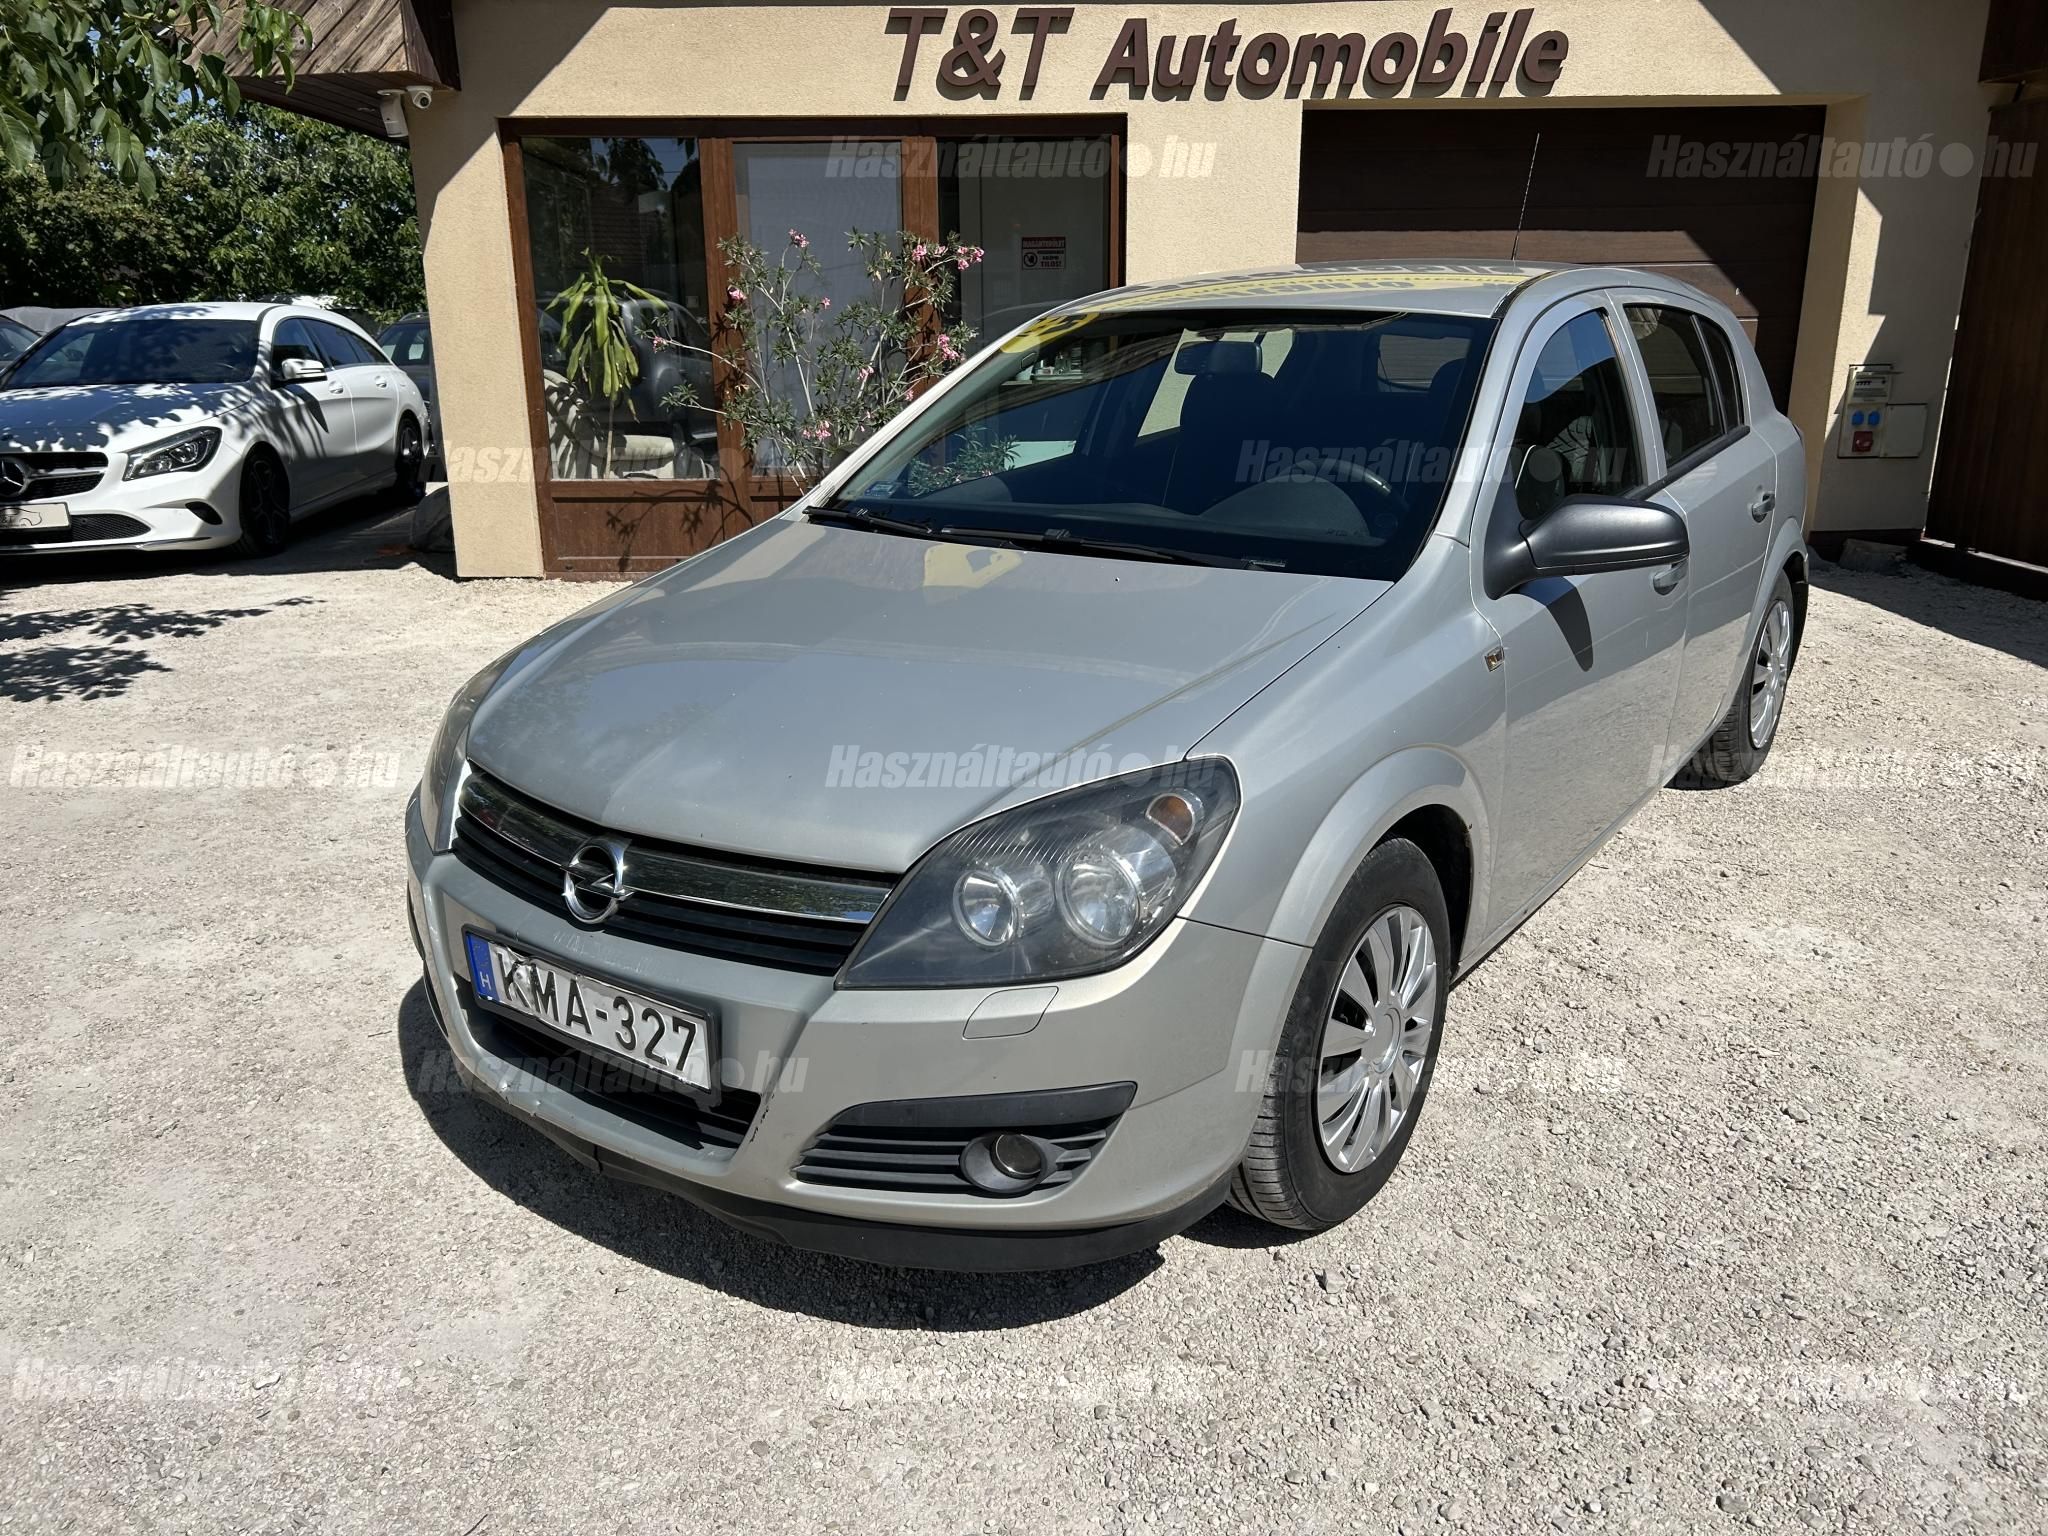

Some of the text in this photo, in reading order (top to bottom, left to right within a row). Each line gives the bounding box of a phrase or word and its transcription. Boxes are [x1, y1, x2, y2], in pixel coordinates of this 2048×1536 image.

[887, 7, 1569, 92] T&T Automobile
[497, 949, 697, 1071] KMA-327
